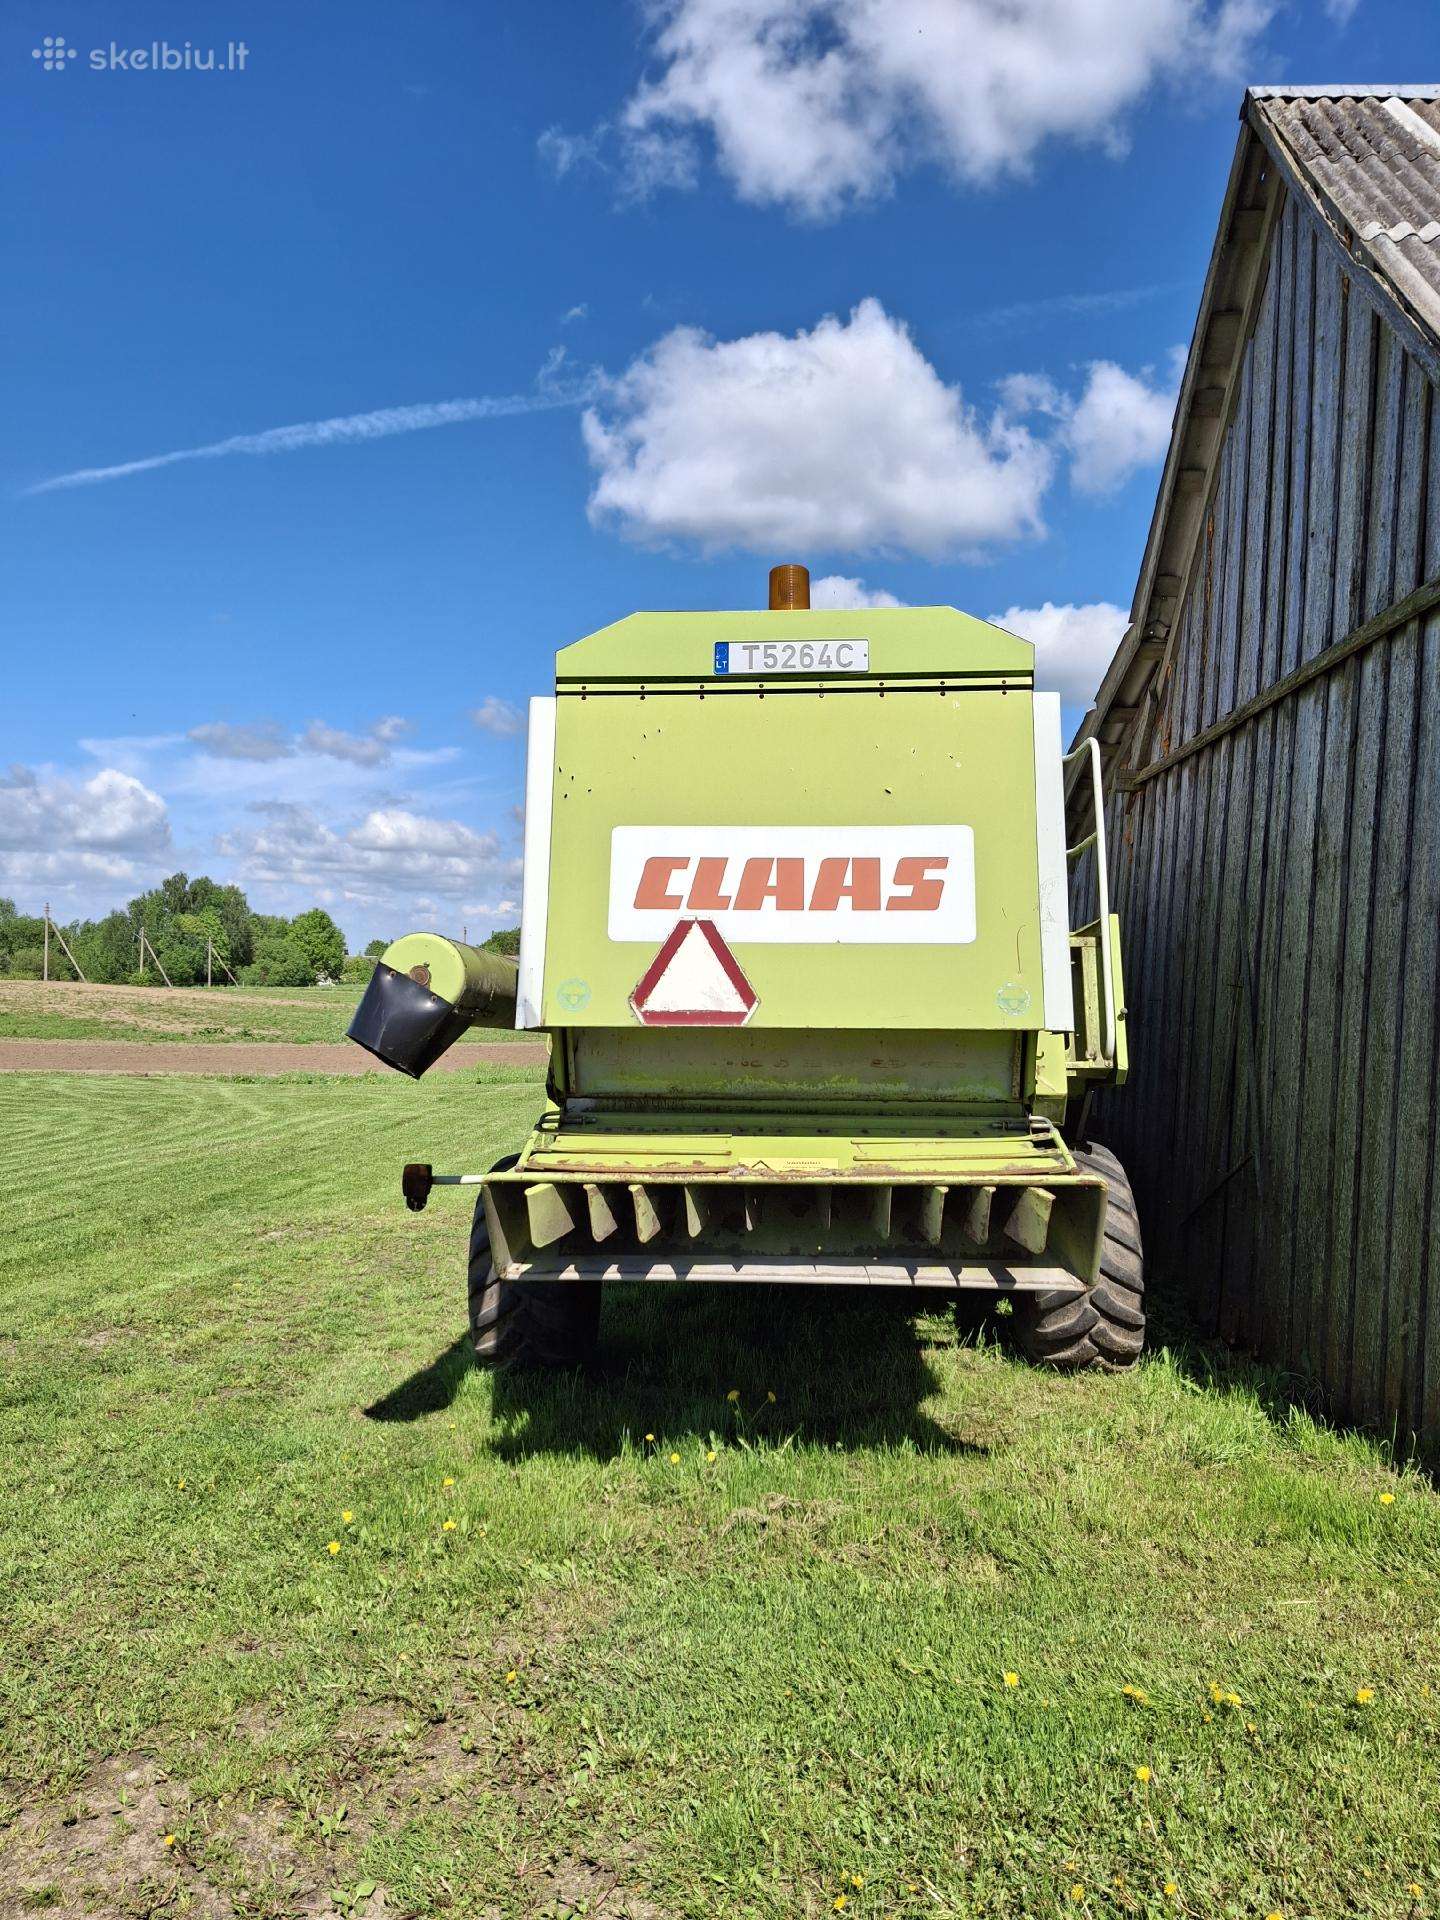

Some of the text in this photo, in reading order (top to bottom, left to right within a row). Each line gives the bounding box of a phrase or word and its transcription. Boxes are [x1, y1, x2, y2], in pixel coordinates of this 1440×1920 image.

[715, 660, 728, 669] LT
[742, 643, 853, 669] T5264C
[633, 857, 949, 911] CLAAS
